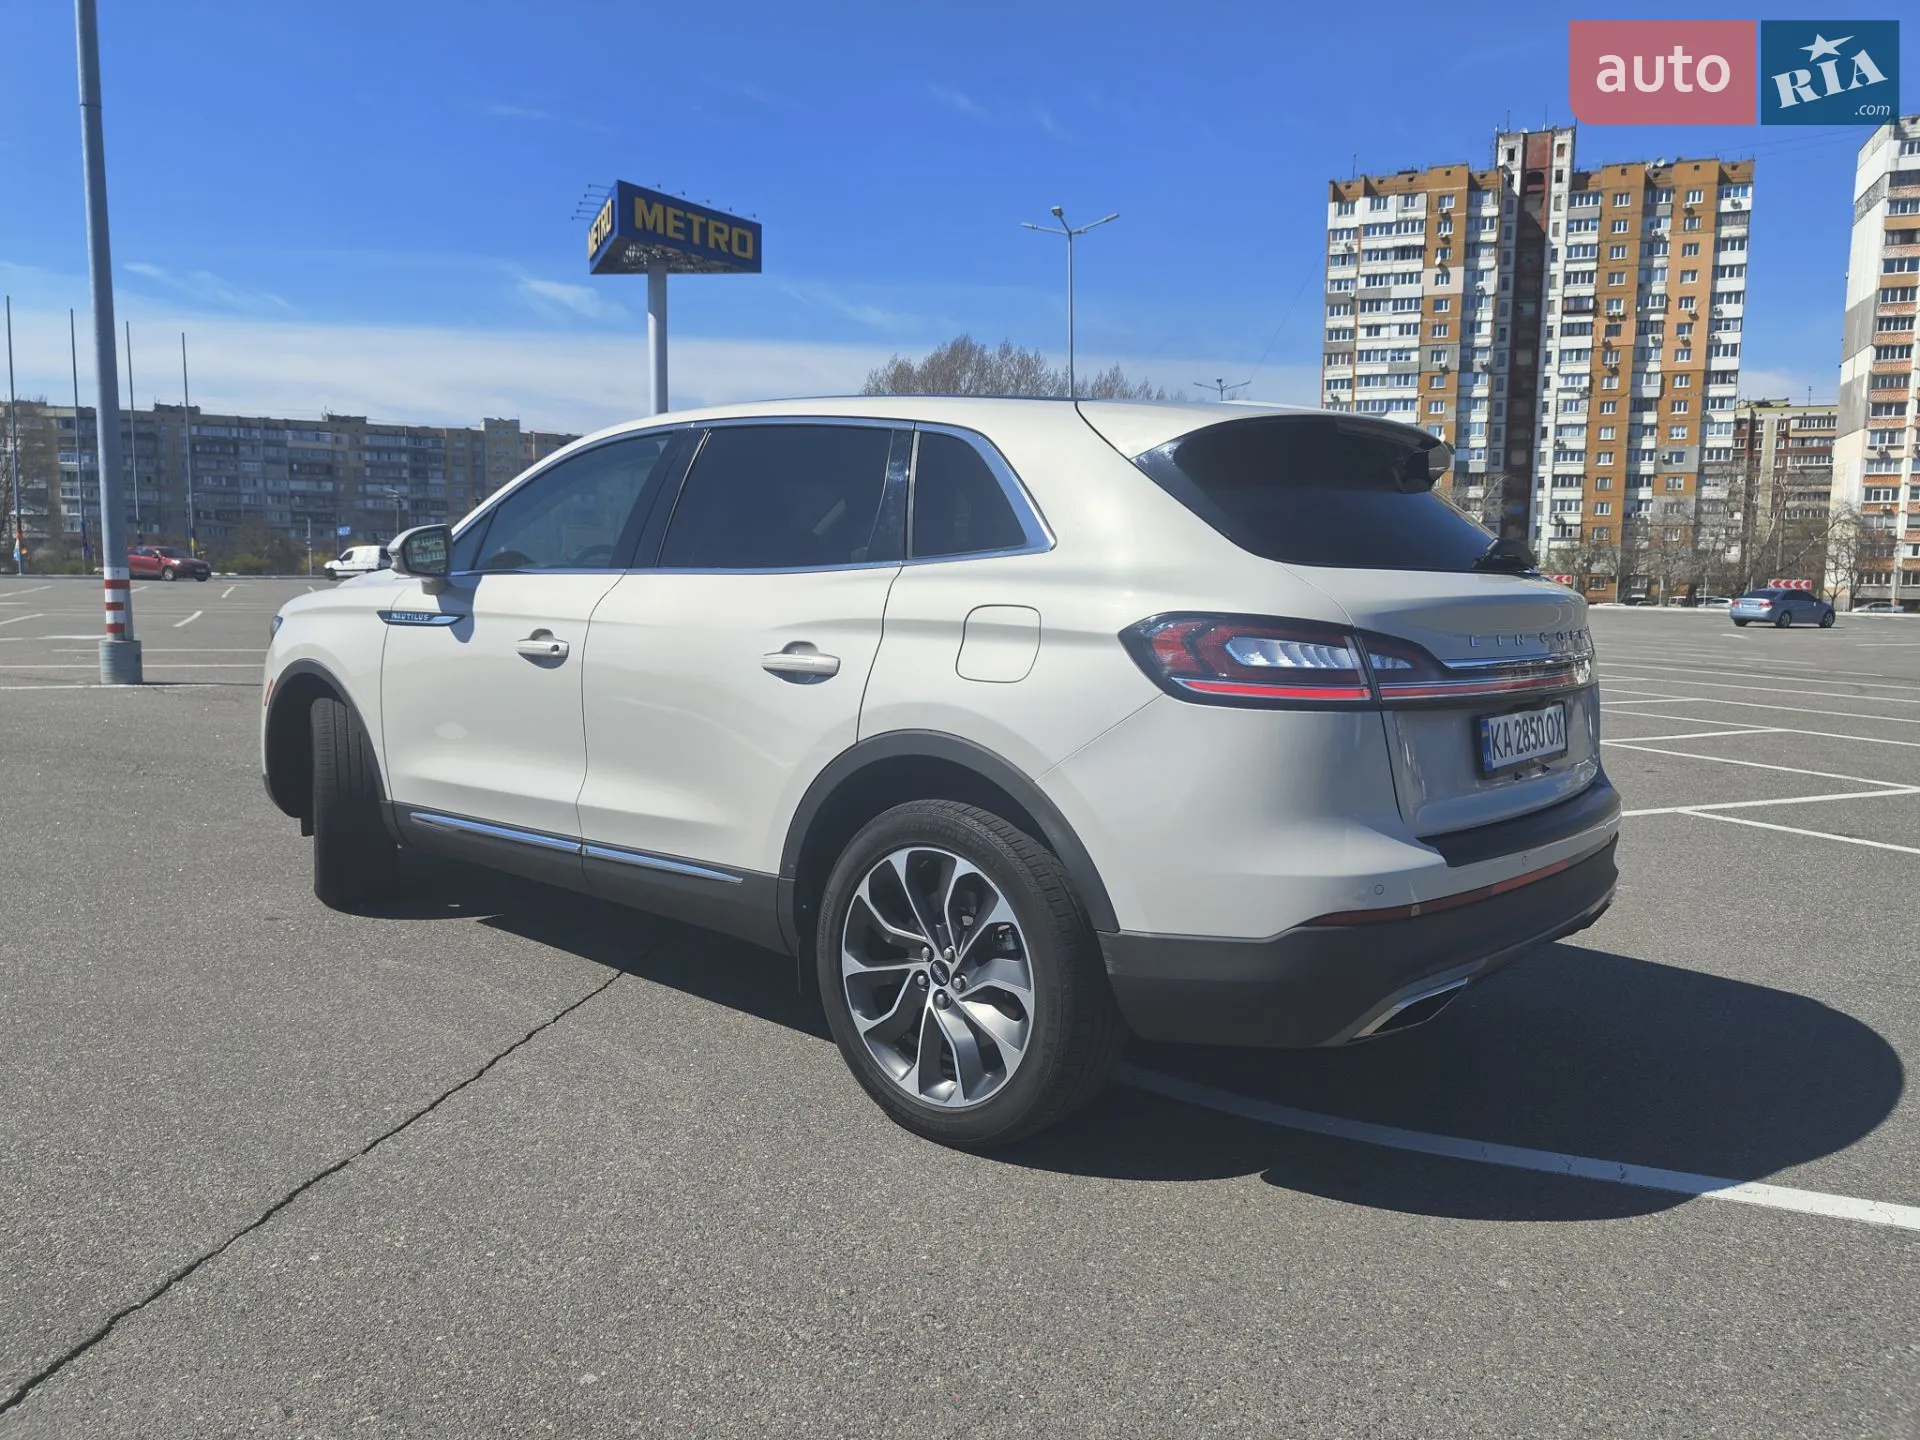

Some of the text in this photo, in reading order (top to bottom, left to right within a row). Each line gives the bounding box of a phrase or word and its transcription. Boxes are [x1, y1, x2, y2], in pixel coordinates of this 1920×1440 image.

[588, 197, 612, 258] METRO
[634, 197, 754, 260] METRO
[391, 612, 429, 621] NAUTILUS
[1491, 711, 1563, 760] KA 2850 OX
